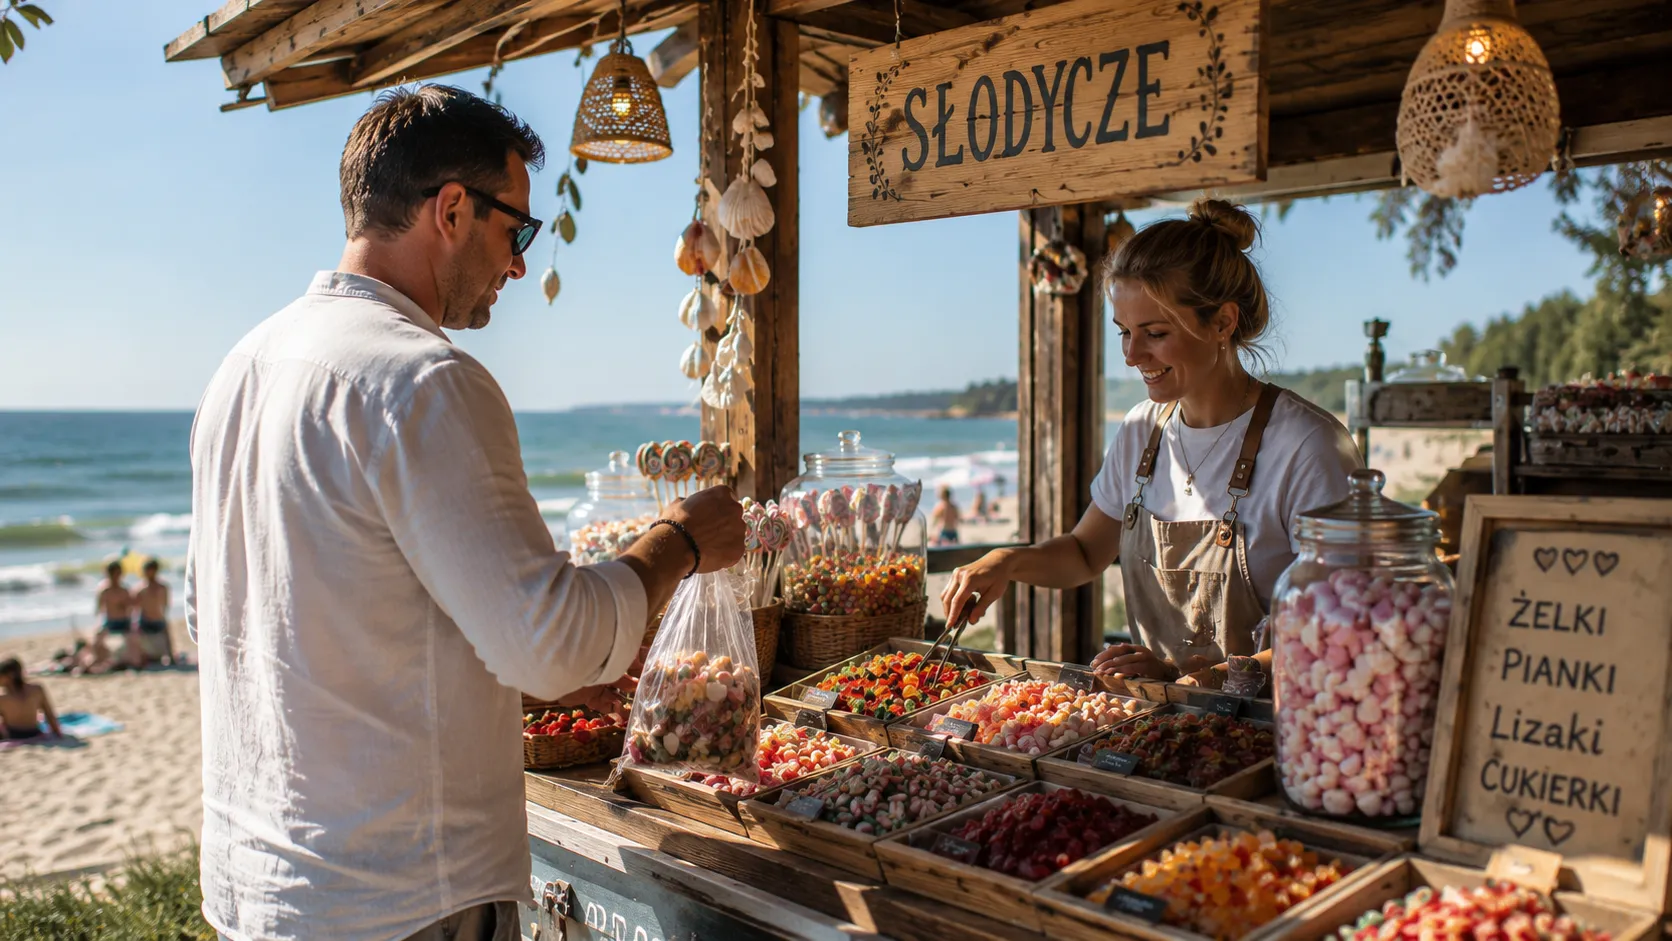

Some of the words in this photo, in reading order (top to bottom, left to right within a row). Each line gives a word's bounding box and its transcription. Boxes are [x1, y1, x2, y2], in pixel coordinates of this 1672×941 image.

[902, 40, 1170, 171] SŁODYCZE
[1508, 590, 1606, 636] ŻELKI
[1501, 648, 1616, 695] PIANKI
[1490, 705, 1603, 755] Lizaki
